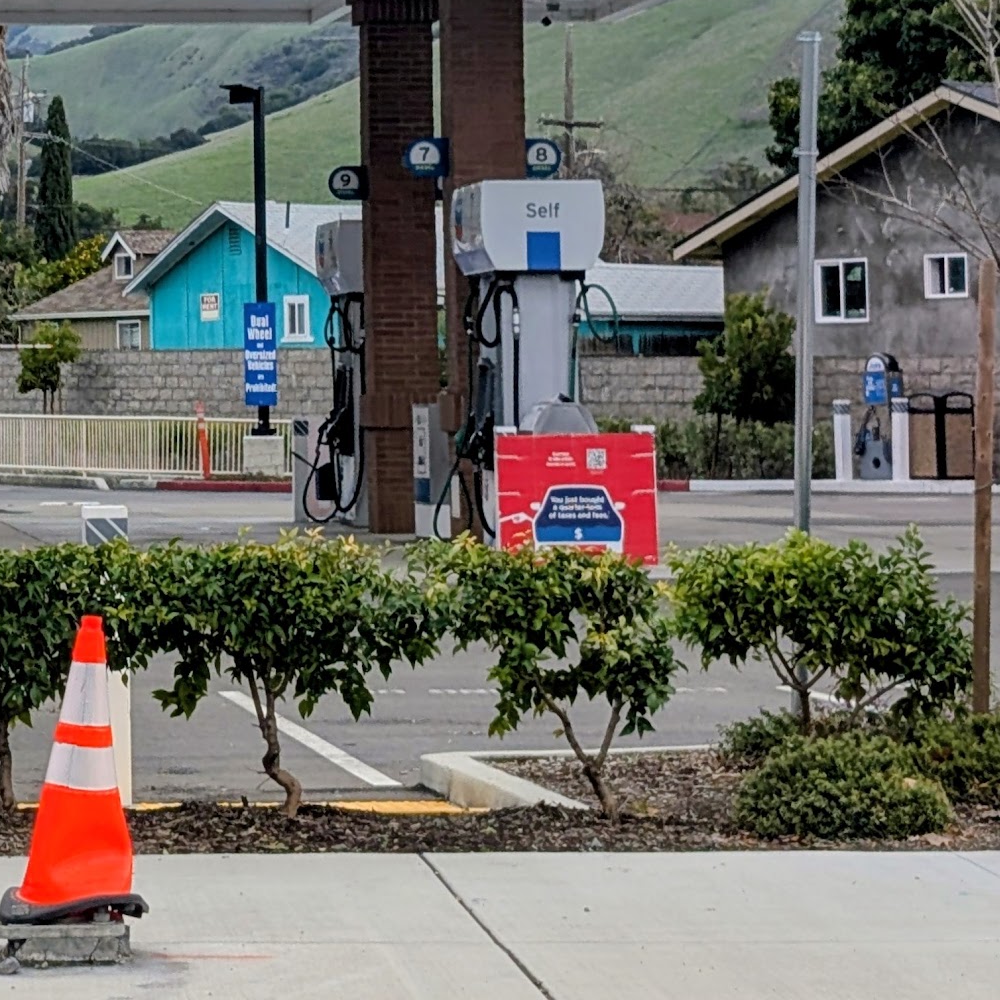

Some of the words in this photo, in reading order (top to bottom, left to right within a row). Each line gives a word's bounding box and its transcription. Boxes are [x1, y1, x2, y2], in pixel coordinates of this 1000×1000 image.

[419, 147, 430, 161] 7
[536, 147, 548, 162] 8
[340, 174, 351, 187] 9
[526, 202, 560, 218] Self
[250, 314, 269, 328] Dual
[247, 327, 272, 340] Wheel
[245, 349, 276, 360] Oversized
